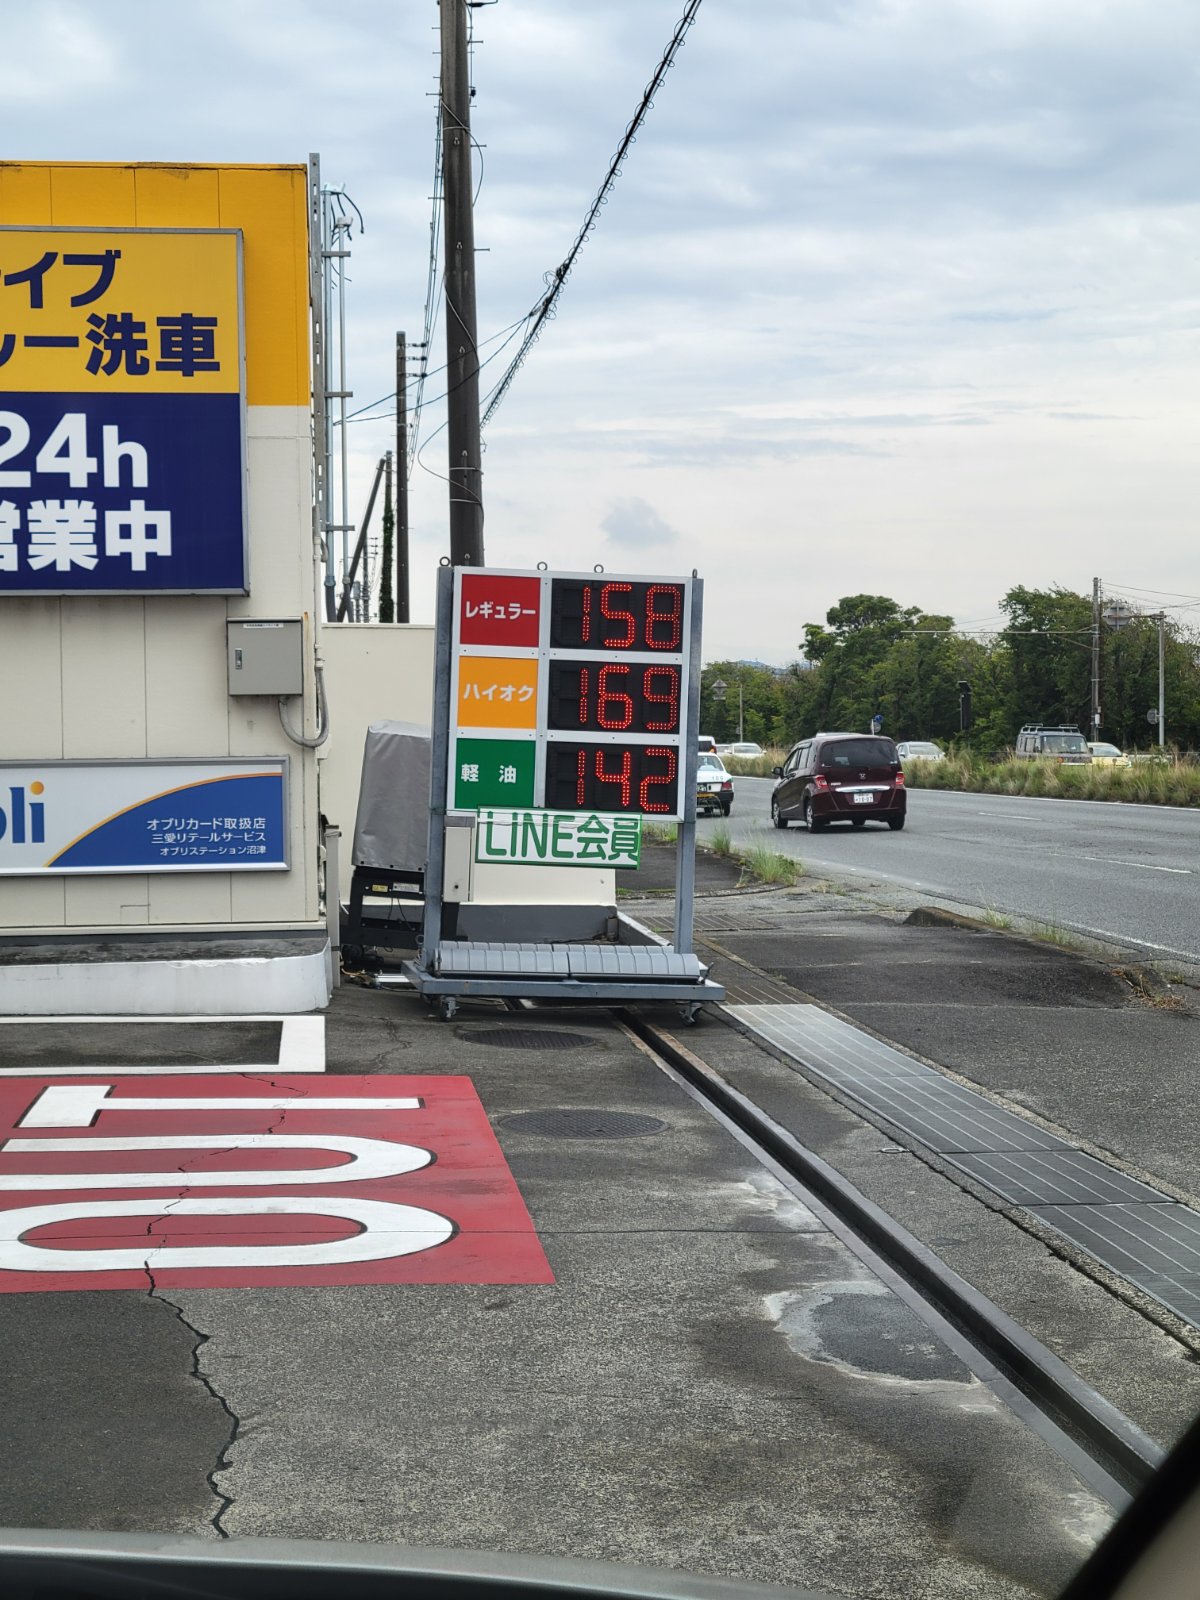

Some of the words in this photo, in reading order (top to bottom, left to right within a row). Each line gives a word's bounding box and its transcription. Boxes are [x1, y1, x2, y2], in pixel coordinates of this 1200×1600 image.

[0, 249, 122, 309] イブ
[0, 410, 149, 489] 24h
[465, 600, 537, 620] レギュラー
[581, 583, 682, 649] 158
[463, 683, 534, 702] ハイオク
[578, 665, 679, 731] 169
[576, 747, 676, 812] 142
[146, 817, 267, 831] オブリカード取扱店
[151, 831, 266, 844] 三愛リテールサービス
[485, 811, 641, 862] LINE会員
[159, 845, 267, 856] オブリステーション沼津
